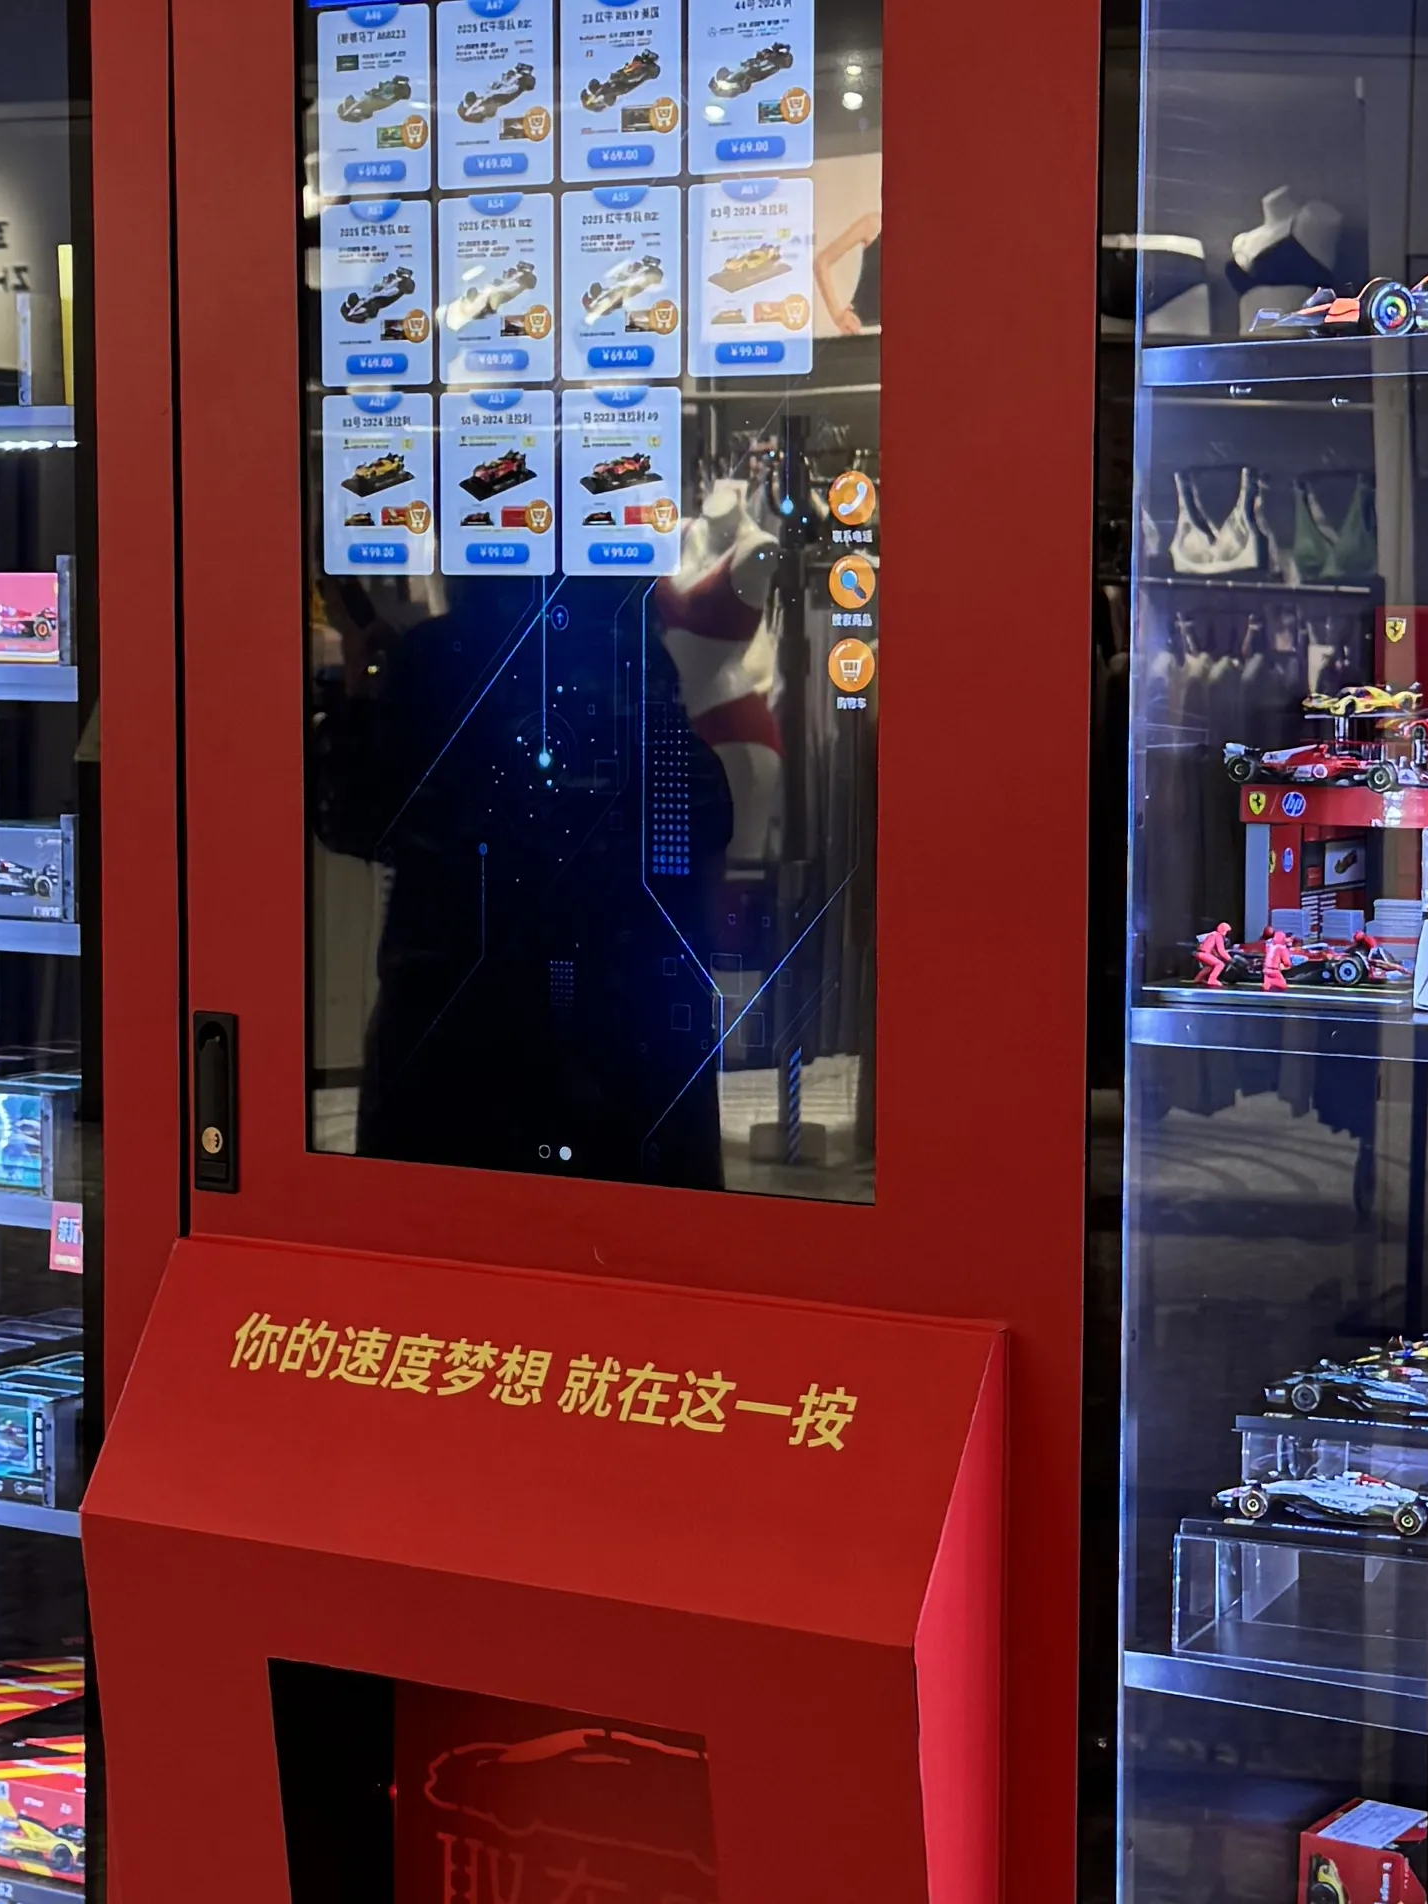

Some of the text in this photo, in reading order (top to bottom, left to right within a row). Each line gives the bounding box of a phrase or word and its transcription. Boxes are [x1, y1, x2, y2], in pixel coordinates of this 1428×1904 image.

[730, 140, 769, 155] ¥69.00
[476, 156, 513, 170] ¥69.00
[601, 349, 639, 362] ¥69.00
[229, 1311, 858, 1452] 你的速度梦想 就在这一按
